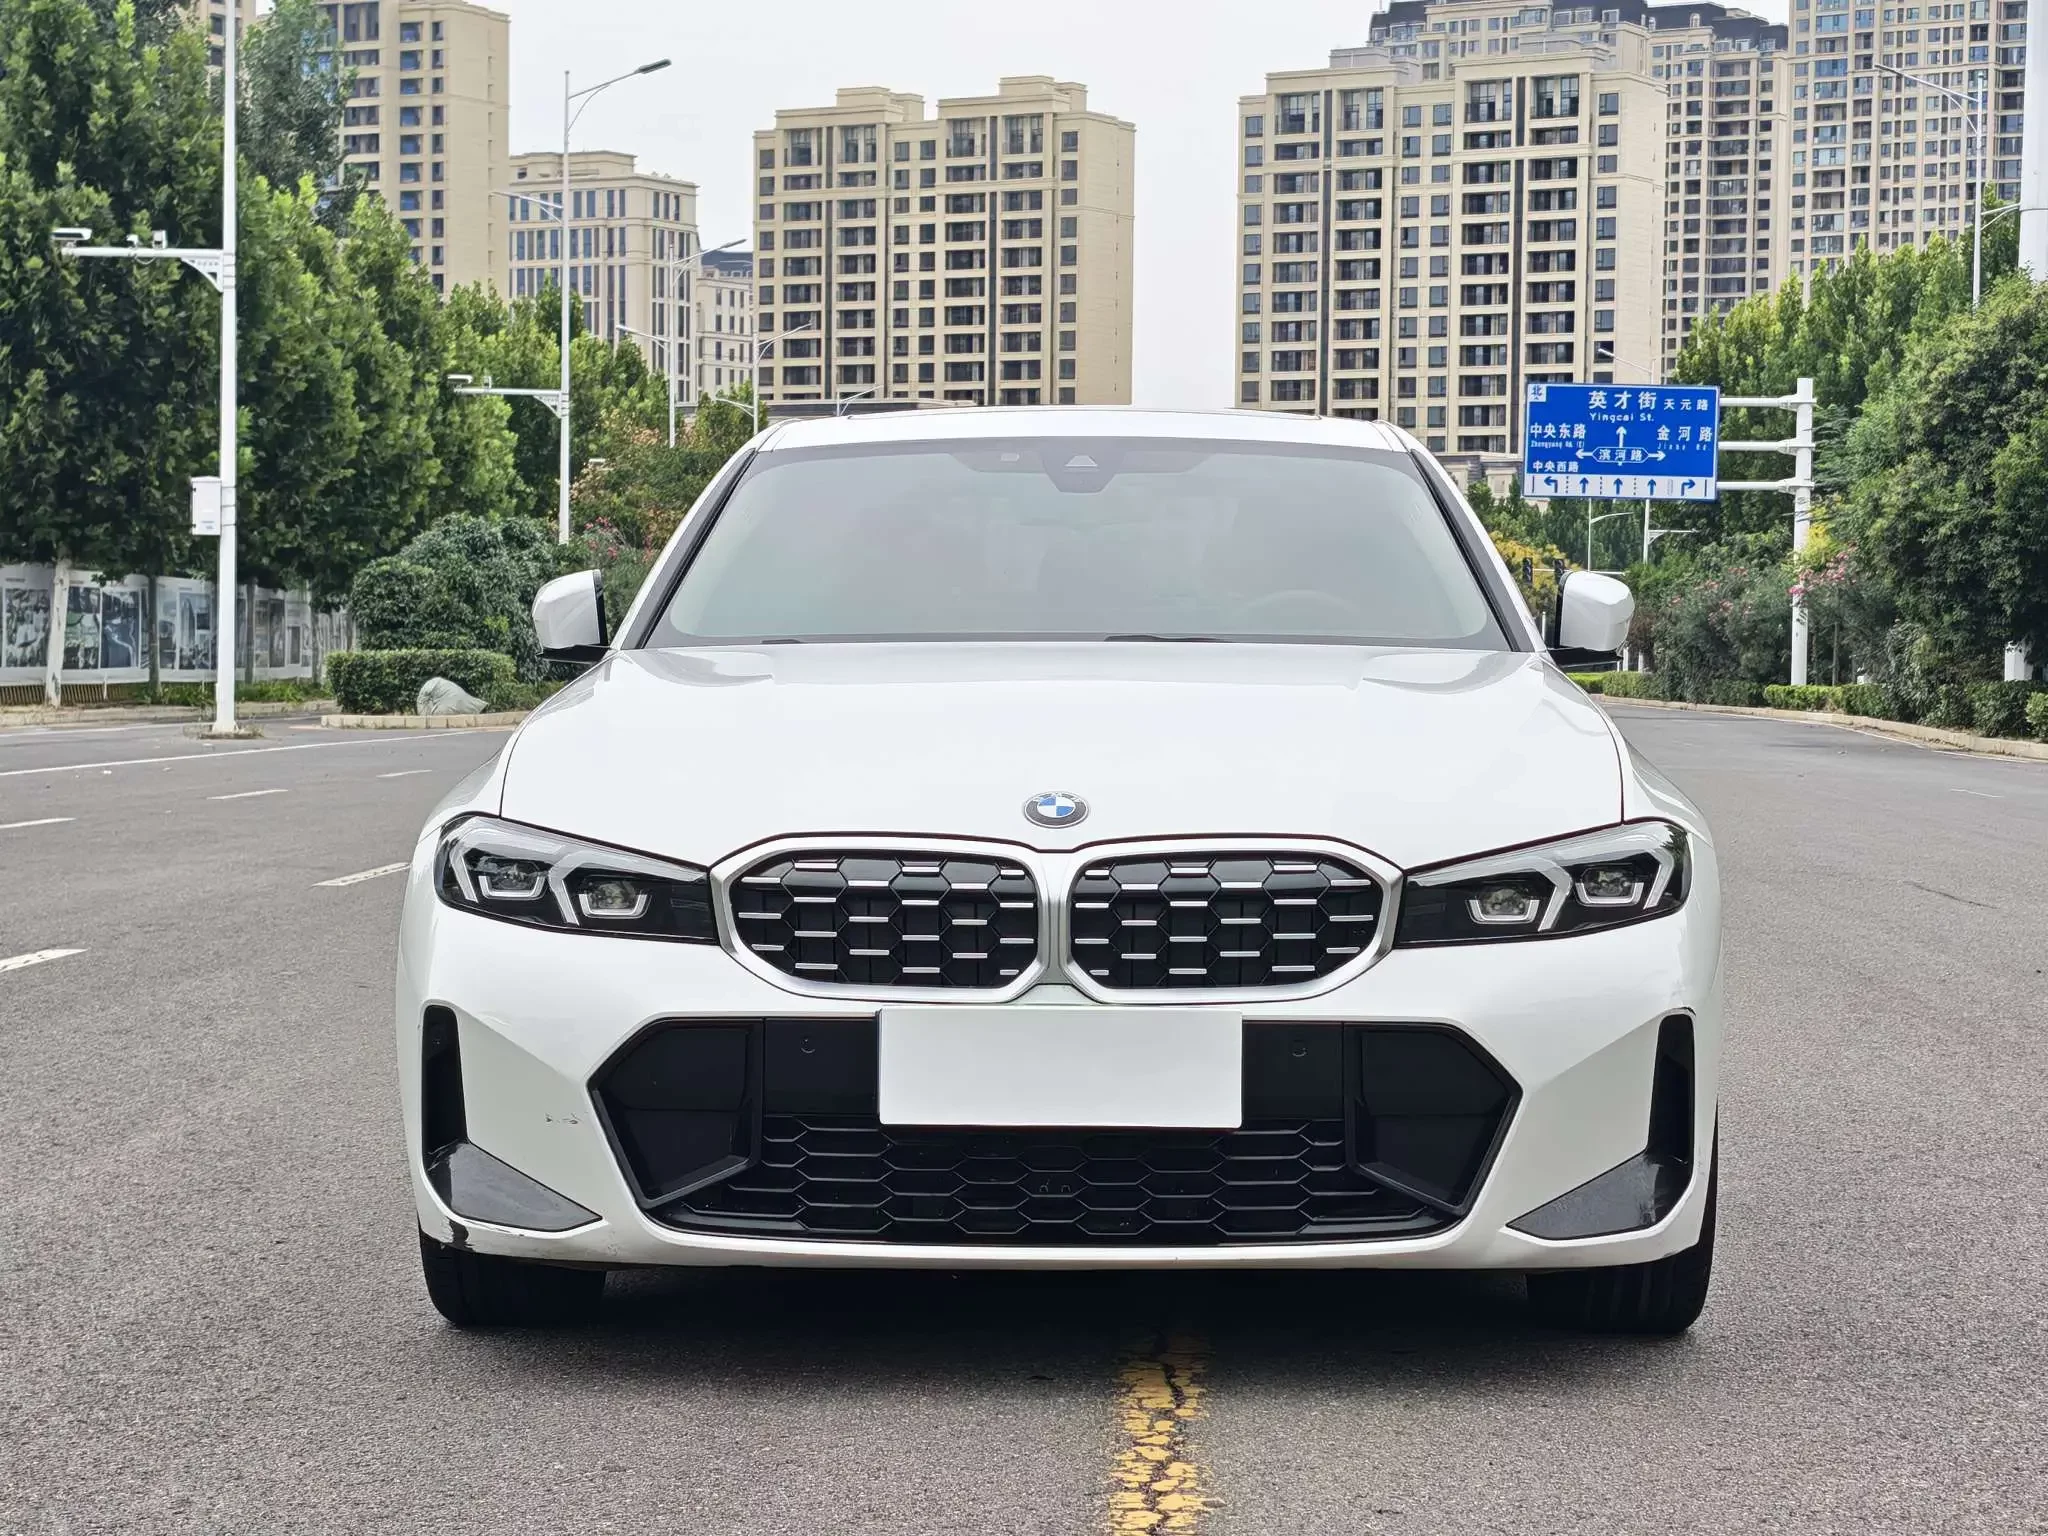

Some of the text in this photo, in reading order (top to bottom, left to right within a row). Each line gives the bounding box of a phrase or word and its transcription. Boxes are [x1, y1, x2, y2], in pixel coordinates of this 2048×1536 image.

[1588, 390, 1657, 410] 英才街
[1663, 398, 1709, 411] 天元路
[1589, 412, 1655, 423] Yingcai St.
[1530, 422, 1586, 439] 中央东路
[1656, 424, 1713, 442] 金河路
[1598, 448, 1643, 461] 滨河路
[1532, 460, 1579, 473] 中央西路
